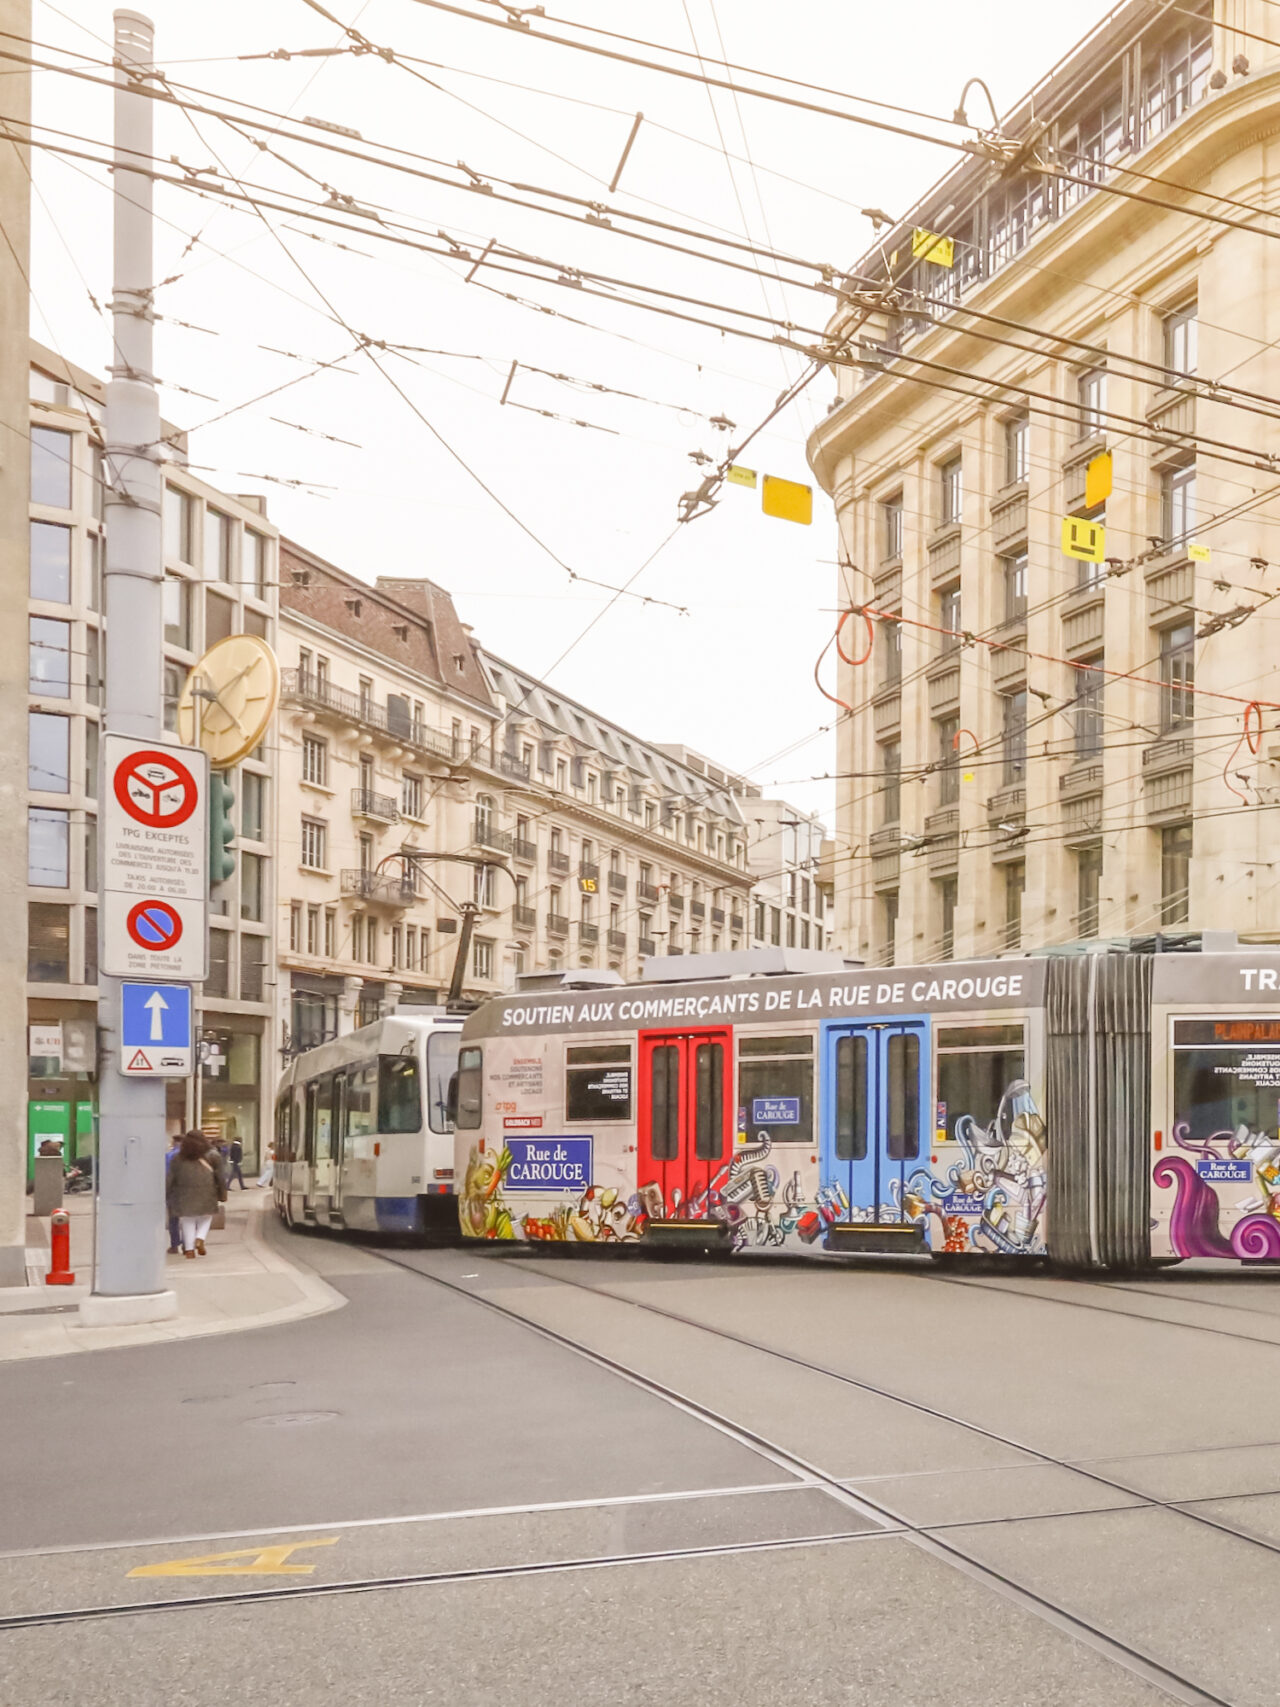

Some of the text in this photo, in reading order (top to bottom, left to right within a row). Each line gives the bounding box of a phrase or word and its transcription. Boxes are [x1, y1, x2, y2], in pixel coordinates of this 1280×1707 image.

[122, 828, 140, 838] TPG
[581, 878, 596, 891] 15
[502, 975, 1023, 1026] SOUTIEN AUX COMMERÇANTS DE LA RUE DE CAROUGE
[764, 1102, 777, 1110] Rue
[756, 1110, 794, 1119] CAROUGE
[526, 1144, 567, 1162] Rue de
[1210, 1162, 1237, 1171] Rue de
[510, 1163, 583, 1180] CAROUGE
[1200, 1170, 1247, 1179] CAROUGE
[945, 1203, 982, 1211] CAROUGE
